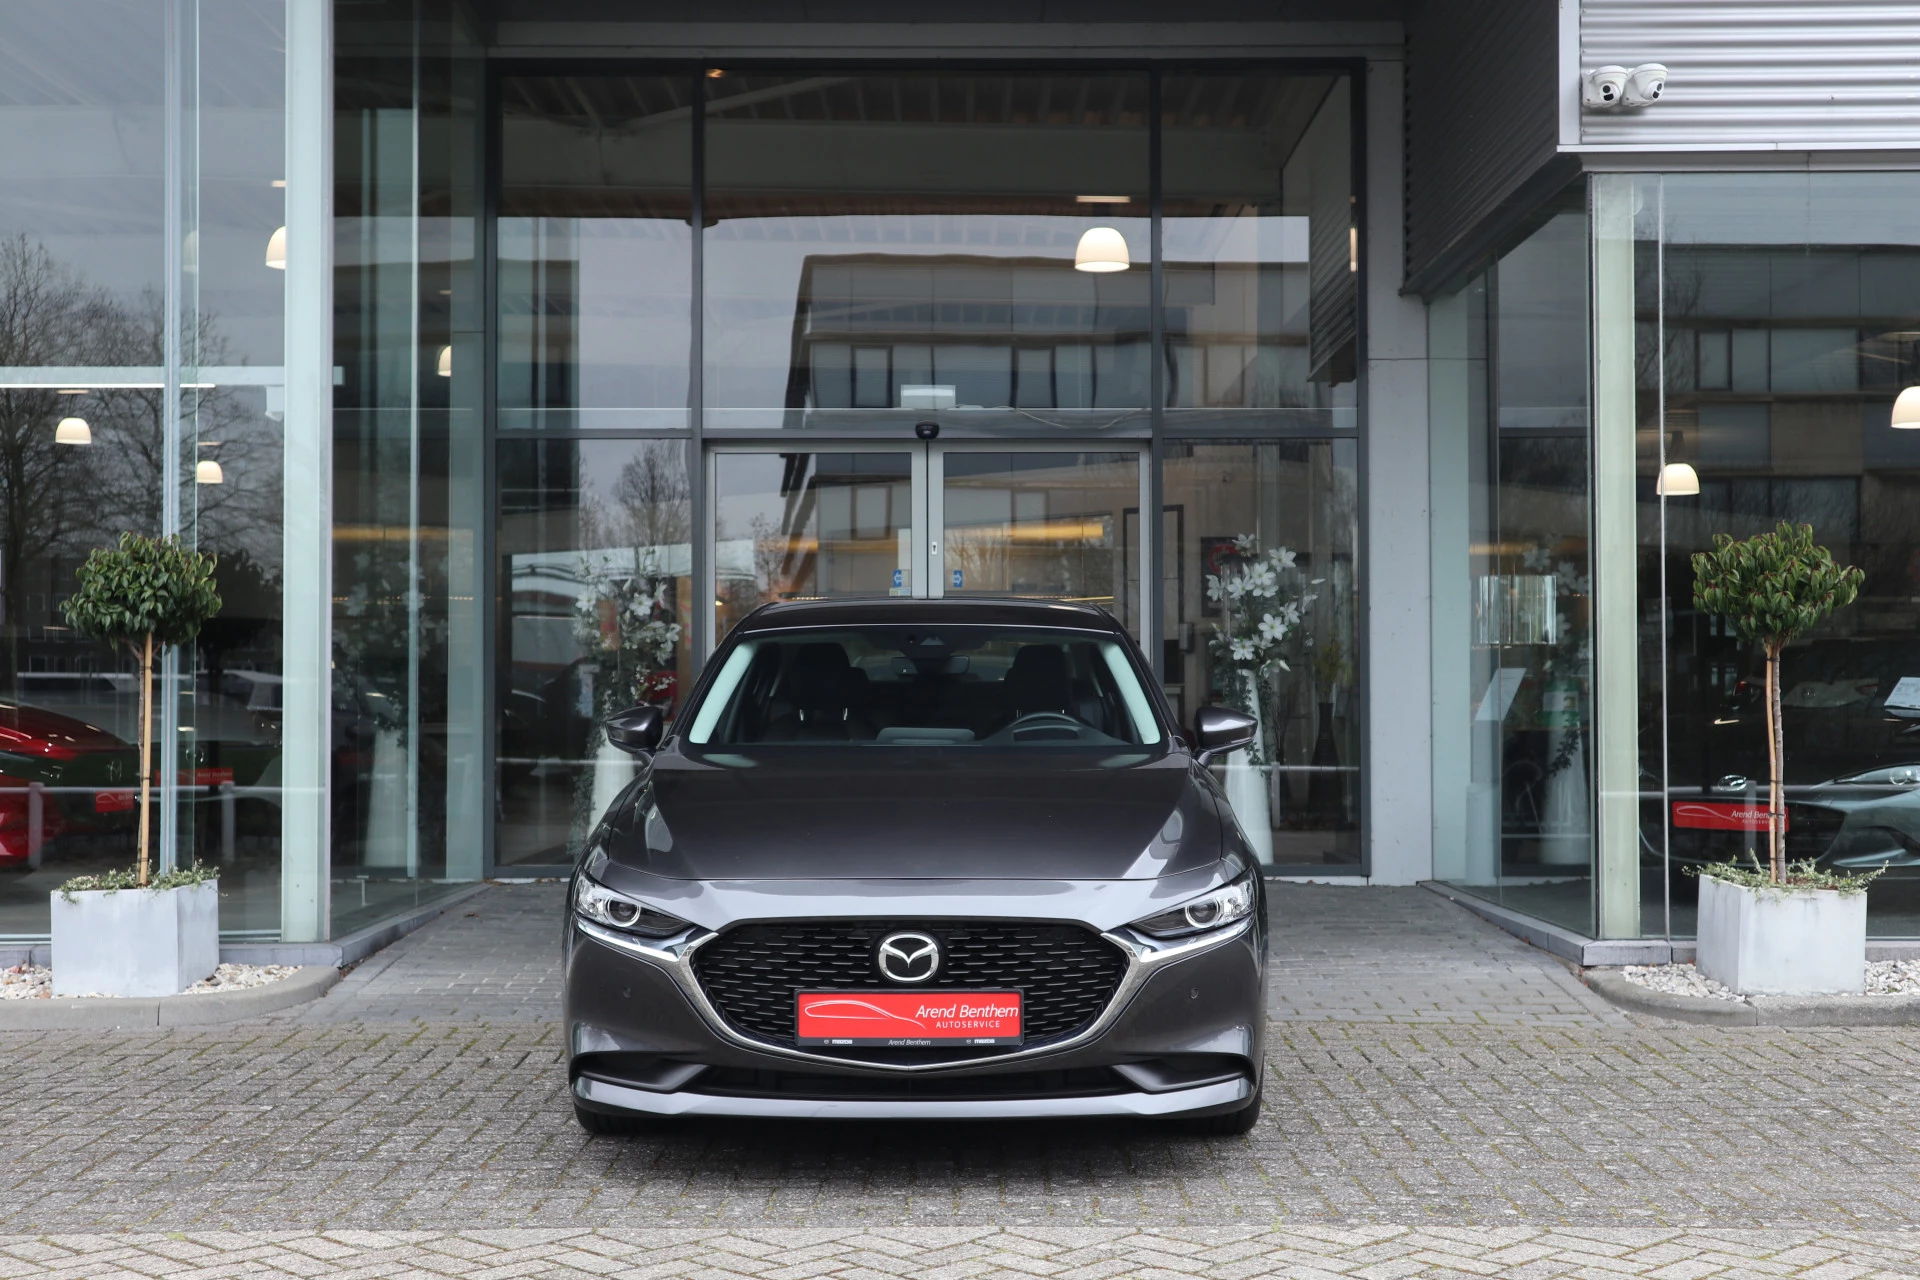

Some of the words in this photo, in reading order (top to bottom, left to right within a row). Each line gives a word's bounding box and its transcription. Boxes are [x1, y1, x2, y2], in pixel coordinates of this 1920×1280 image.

[1731, 810, 1753, 818] Arend
[915, 1004, 957, 1018] Arend
[959, 1003, 1019, 1018] Benthem
[935, 1020, 1001, 1029] AUTOSERVICE
